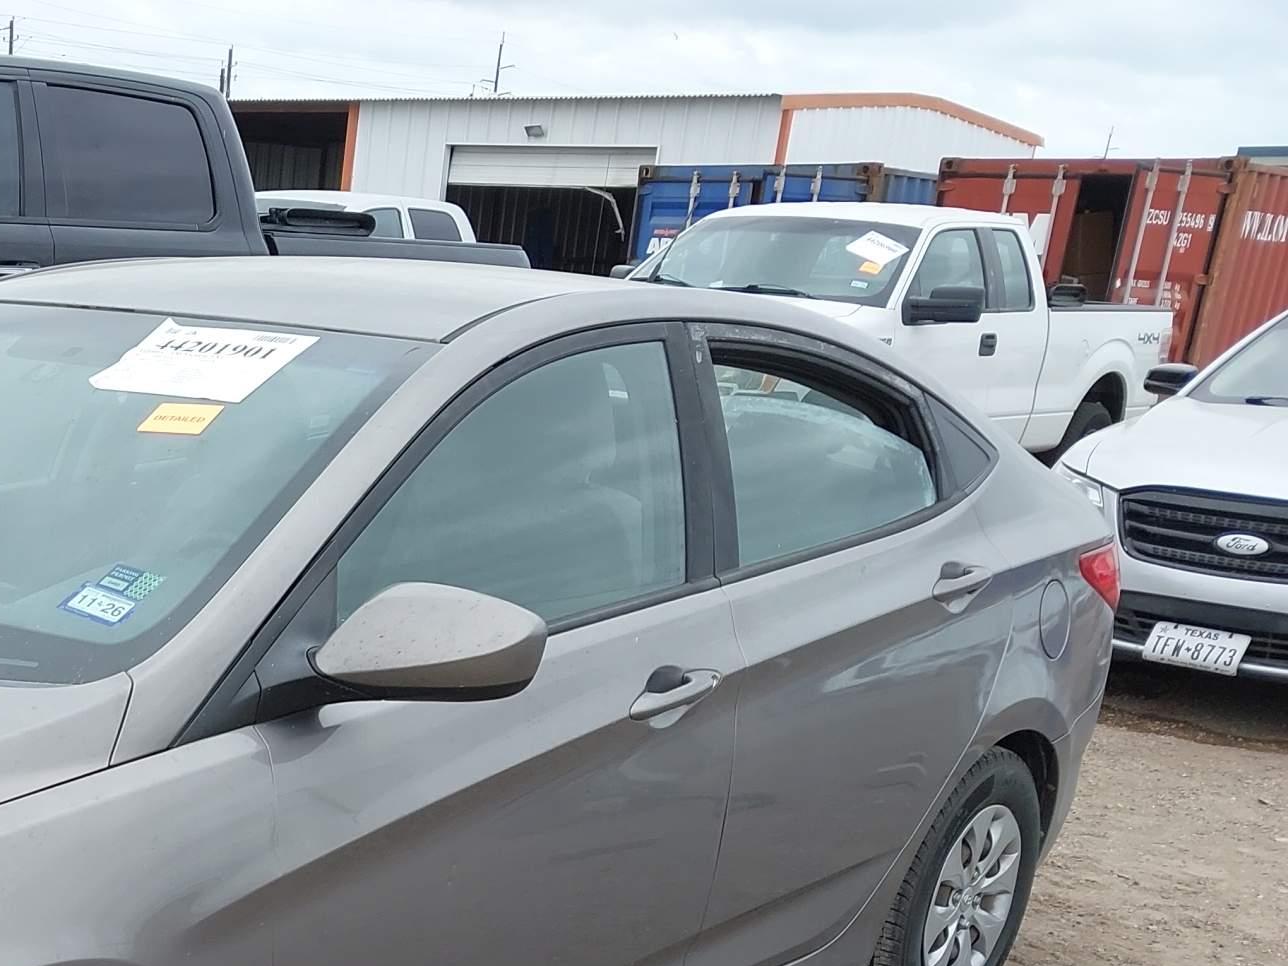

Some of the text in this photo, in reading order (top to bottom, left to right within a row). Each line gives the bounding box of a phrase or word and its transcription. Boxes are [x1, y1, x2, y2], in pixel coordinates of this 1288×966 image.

[1146, 208, 1171, 225] ZCSU
[156, 338, 277, 360] 44201901
[152, 414, 207, 425] DETAILED
[1226, 536, 1258, 552] Ford
[1184, 627, 1220, 641] TEXAS
